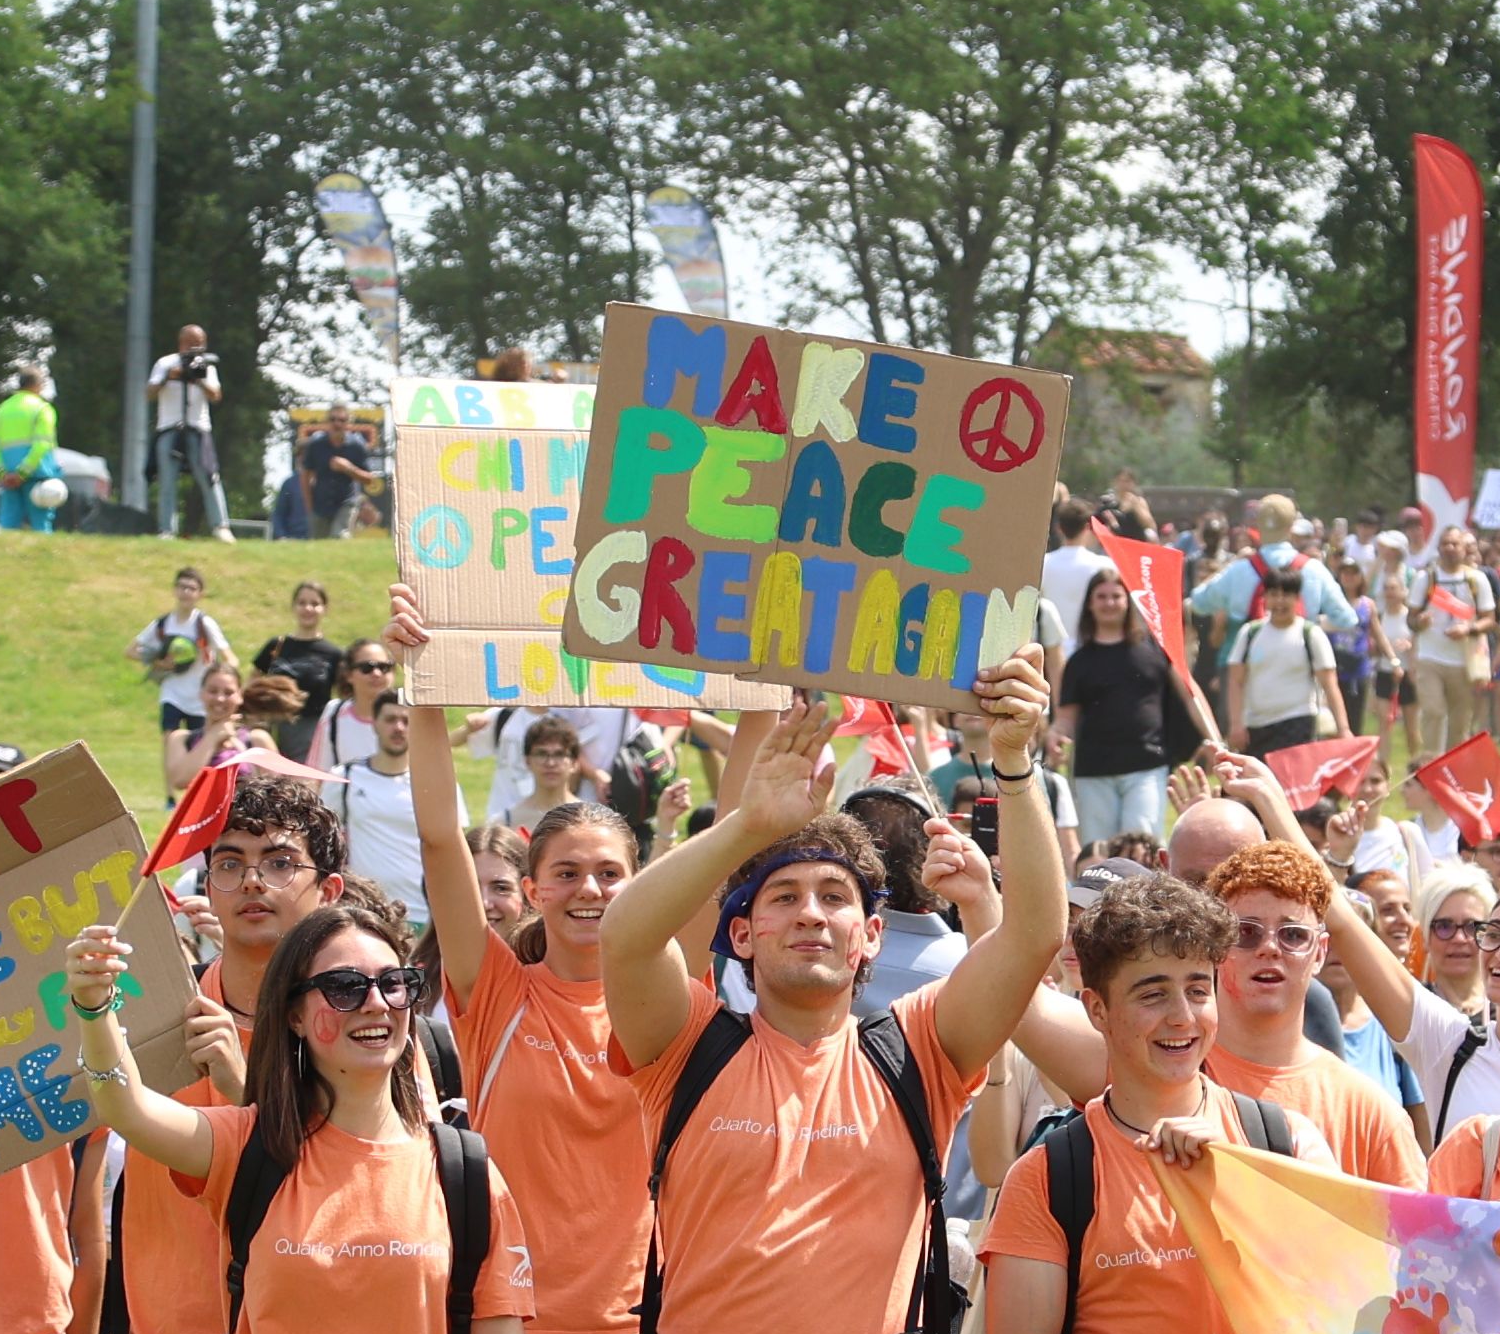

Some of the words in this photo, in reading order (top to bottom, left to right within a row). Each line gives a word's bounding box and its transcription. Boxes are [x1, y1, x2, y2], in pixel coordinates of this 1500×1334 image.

[642, 315, 925, 453] MAKE
[438, 439, 525, 492] CHI
[603, 406, 986, 575] PEACE
[491, 506, 576, 575] PE
[574, 530, 858, 674] GREAT
[847, 569, 1039, 690] AGAIN
[484, 642, 638, 700] LOVE
[7, 850, 137, 955] BUT
[709, 1116, 762, 1134] Quarto
[275, 1237, 335, 1260] Quarto
[337, 1241, 385, 1259] Anno
[1095, 1249, 1153, 1269] Quarto
